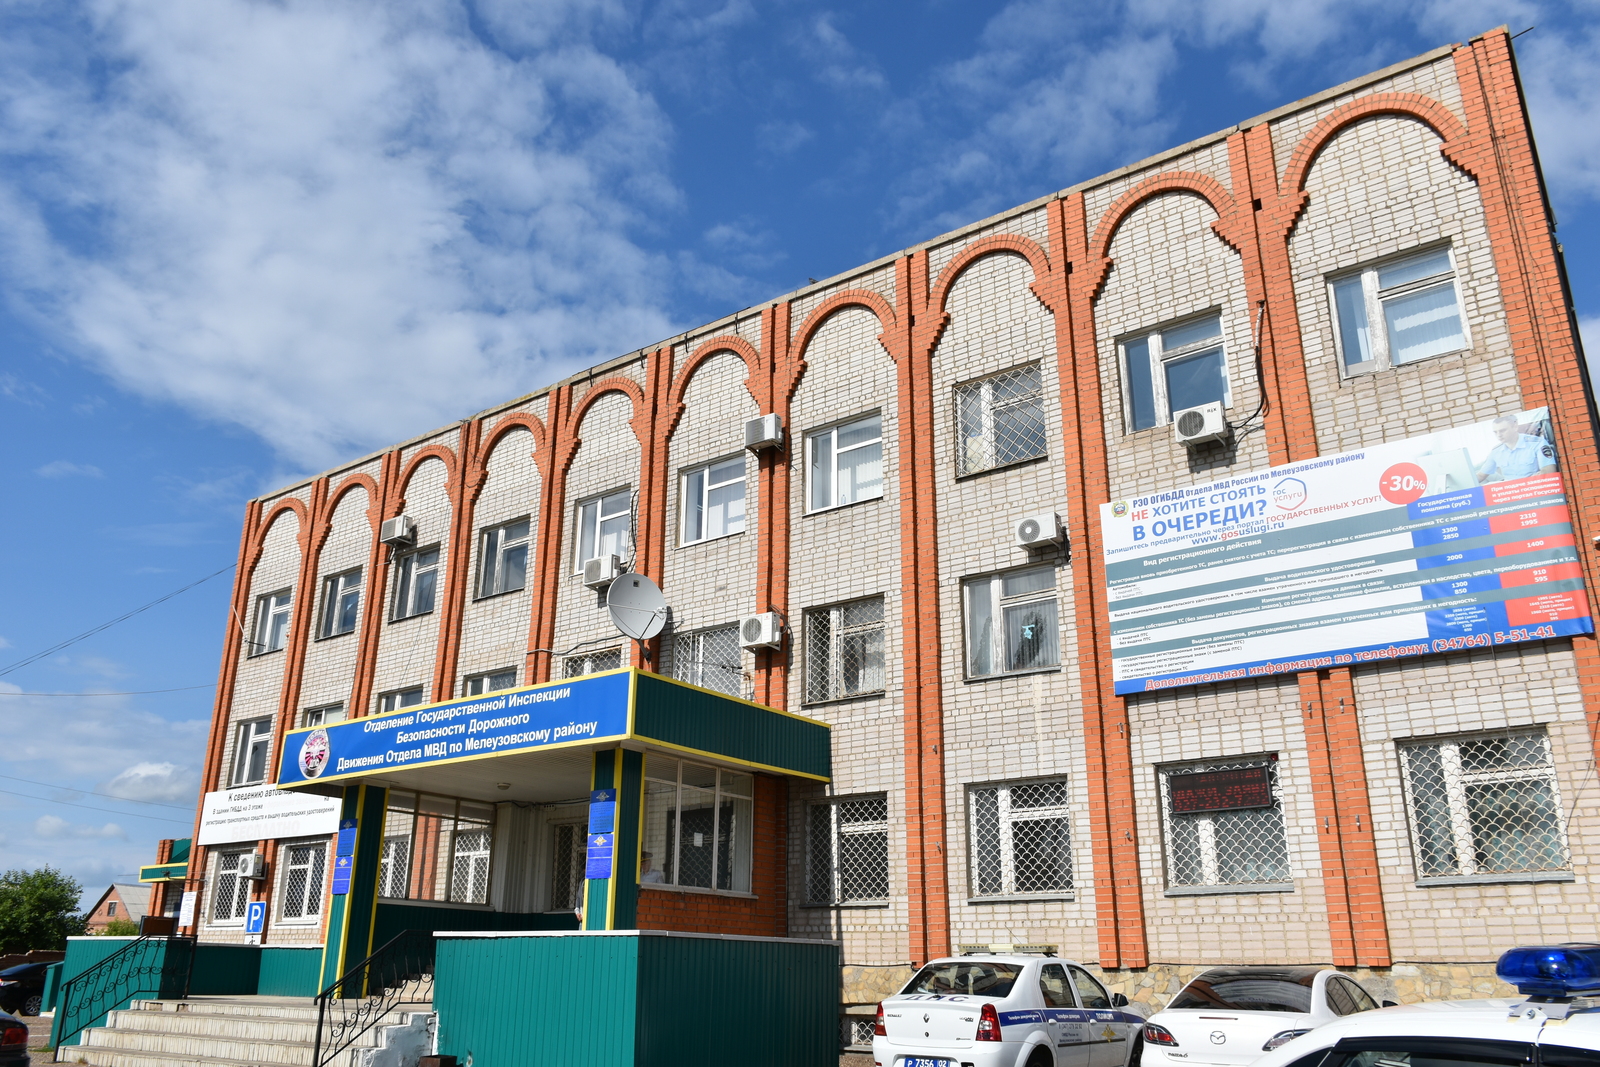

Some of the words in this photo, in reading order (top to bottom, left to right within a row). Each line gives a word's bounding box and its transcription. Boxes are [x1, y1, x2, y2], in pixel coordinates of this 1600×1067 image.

[1132, 497, 1148, 508] РЭО
[1150, 489, 1184, 504] ОГИБДД
[1185, 485, 1212, 496] Отдела
[1213, 480, 1230, 490] МВД
[1231, 475, 1258, 486] России
[1270, 459, 1333, 478] Мелеузовскому
[1335, 452, 1364, 465] району
[1131, 508, 1148, 521] НЕ
[1152, 496, 1205, 517] ХОТИТЕ
[1209, 484, 1266, 504] СТОЯТЬ
[1273, 491, 1302, 503] услуги
[1417, 493, 1472, 507] Государственная
[1420, 504, 1450, 513] пошлина
[1451, 499, 1471, 508] (руб.)
[1106, 543, 1148, 555] Запишитесь
[1150, 529, 1211, 546] предварительно
[1212, 525, 1234, 533] через
[1236, 519, 1264, 528] портал
[1266, 501, 1349, 524] ГОСУДАРСТВЕННЫХ
[1350, 494, 1381, 506] УСЛУГ!
[1132, 525, 1145, 541] В
[1151, 499, 1266, 536] ОЧЕРЕДИ?
[1191, 521, 1284, 545] www.gosuslugi.ru
[1521, 518, 1538, 526] 1995
[1158, 546, 1225, 564] регистрационного
[1226, 539, 1261, 551] действия
[1446, 553, 1462, 561] 2000
[1264, 574, 1286, 582] Выдача
[1287, 567, 1330, 578] водительского
[1330, 559, 1375, 571] удостоверения
[1451, 580, 1468, 588] 1300
[1144, 667, 1246, 691] Дополнительная
[1248, 656, 1332, 676] информация
[1334, 653, 1352, 664] по
[1353, 643, 1429, 661] телефону:
[1431, 633, 1491, 653] (34764)
[1493, 624, 1556, 643] 5-51-41
[363, 715, 414, 732] Отделение
[415, 696, 505, 723] Государственной
[508, 687, 570, 707] Инспекции
[396, 723, 465, 743] Безопасности
[467, 713, 529, 732] Дорожного
[336, 754, 384, 771] Движения
[385, 748, 421, 763] Отдела
[424, 741, 446, 757] МВД
[449, 742, 462, 753] по
[464, 728, 550, 750] Мелеузовскому
[553, 721, 597, 740] району
[249, 904, 262, 931] P
